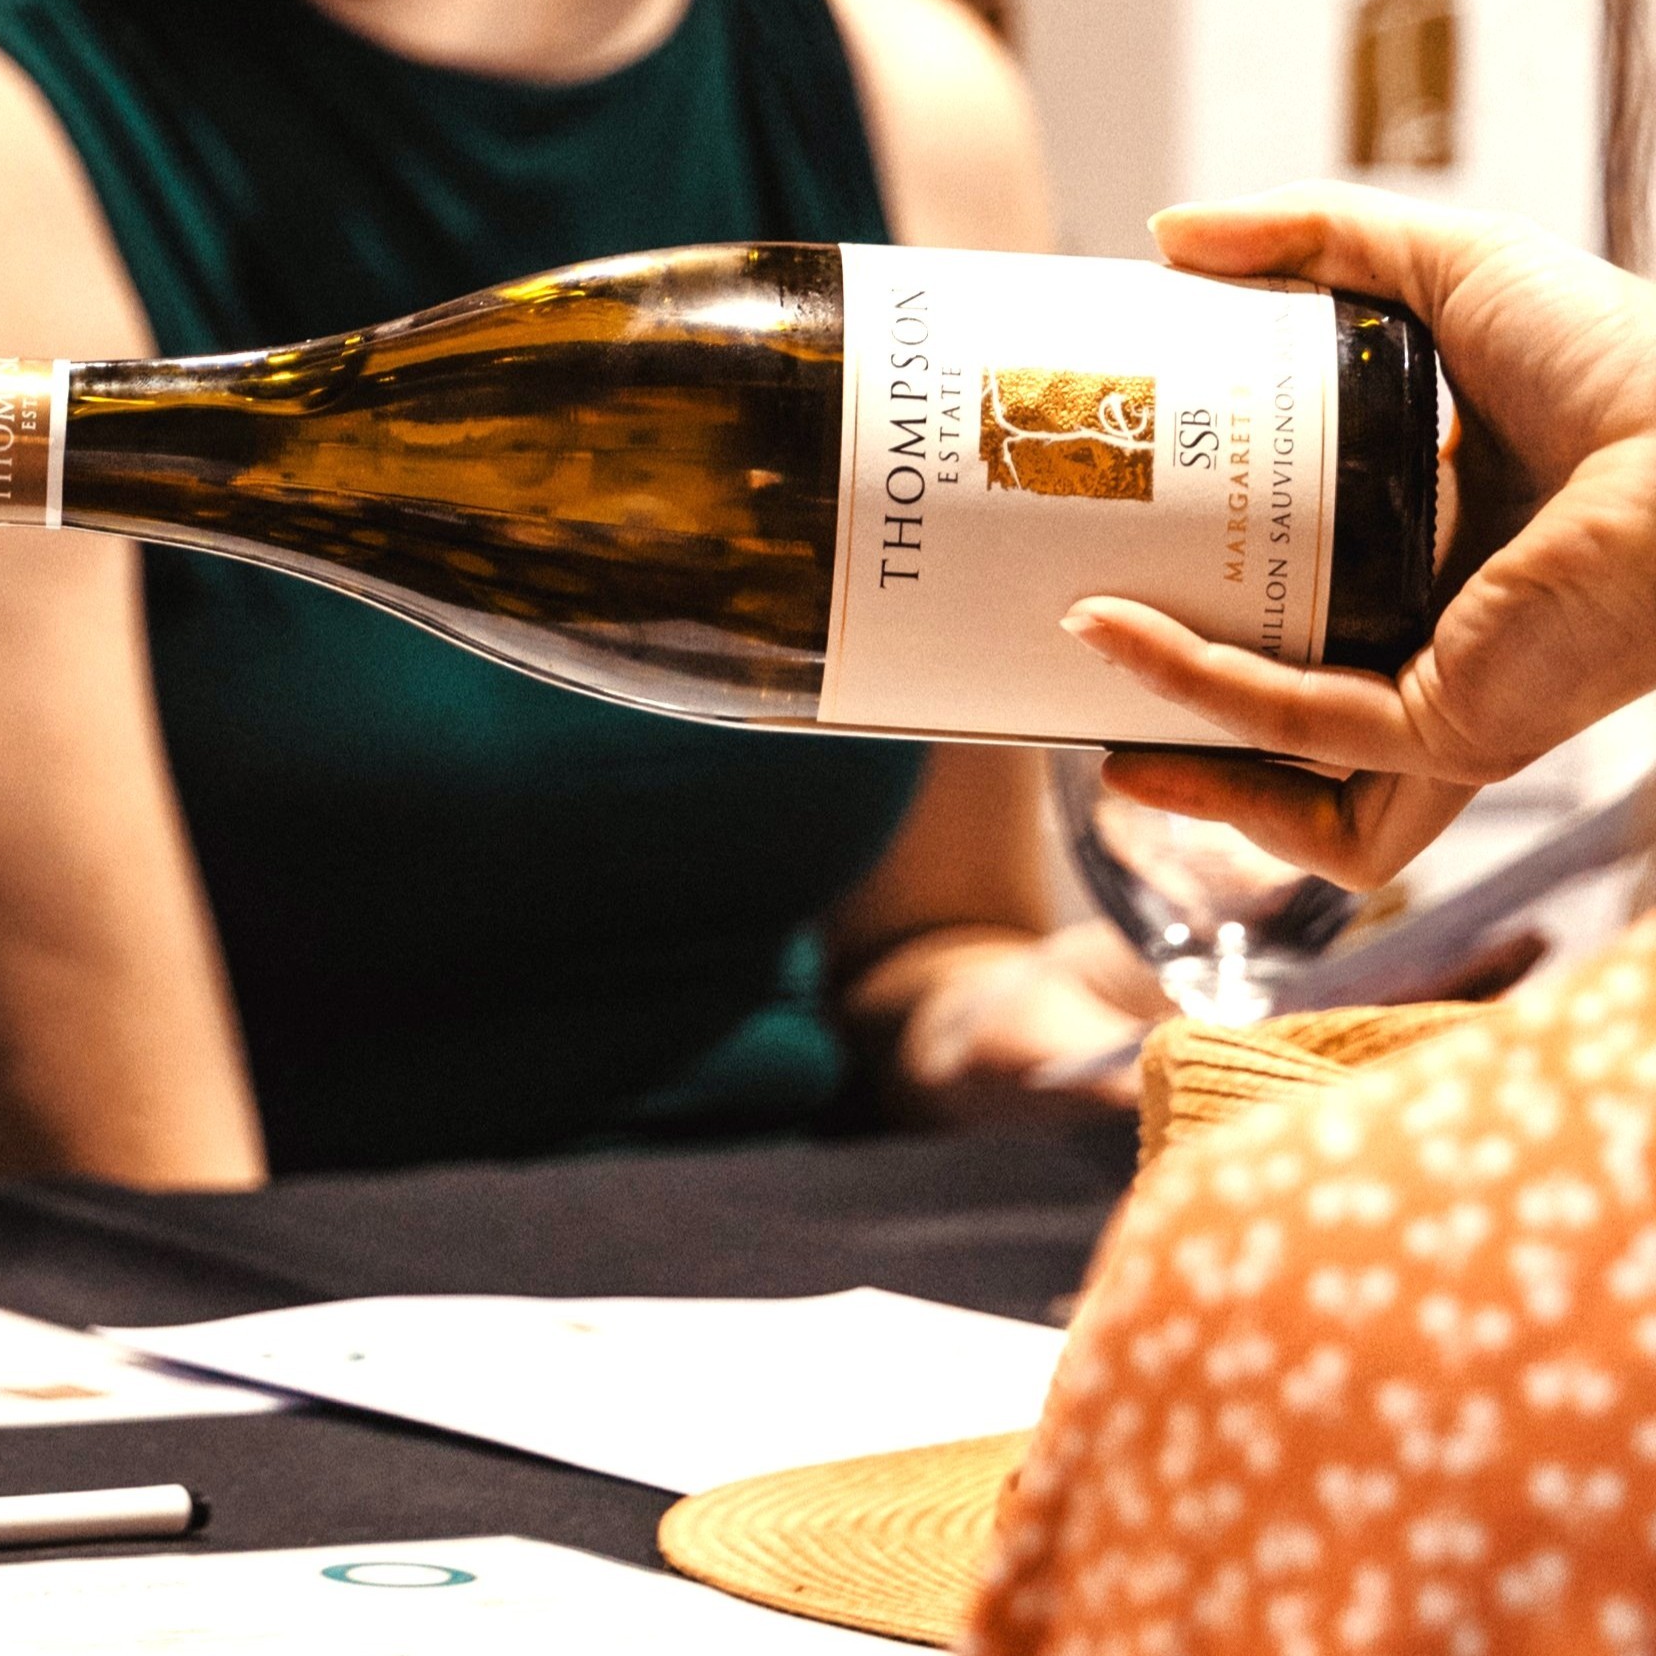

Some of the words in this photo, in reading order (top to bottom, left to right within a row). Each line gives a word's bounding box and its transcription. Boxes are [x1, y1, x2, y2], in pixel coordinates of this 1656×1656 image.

[878, 287, 930, 589] THOMPSON
[937, 367, 961, 484] ESTATE
[1180, 407, 1219, 470] SSB
[1223, 413, 1251, 583] MARGARET
[1269, 374, 1295, 544] SAUVIGNON
